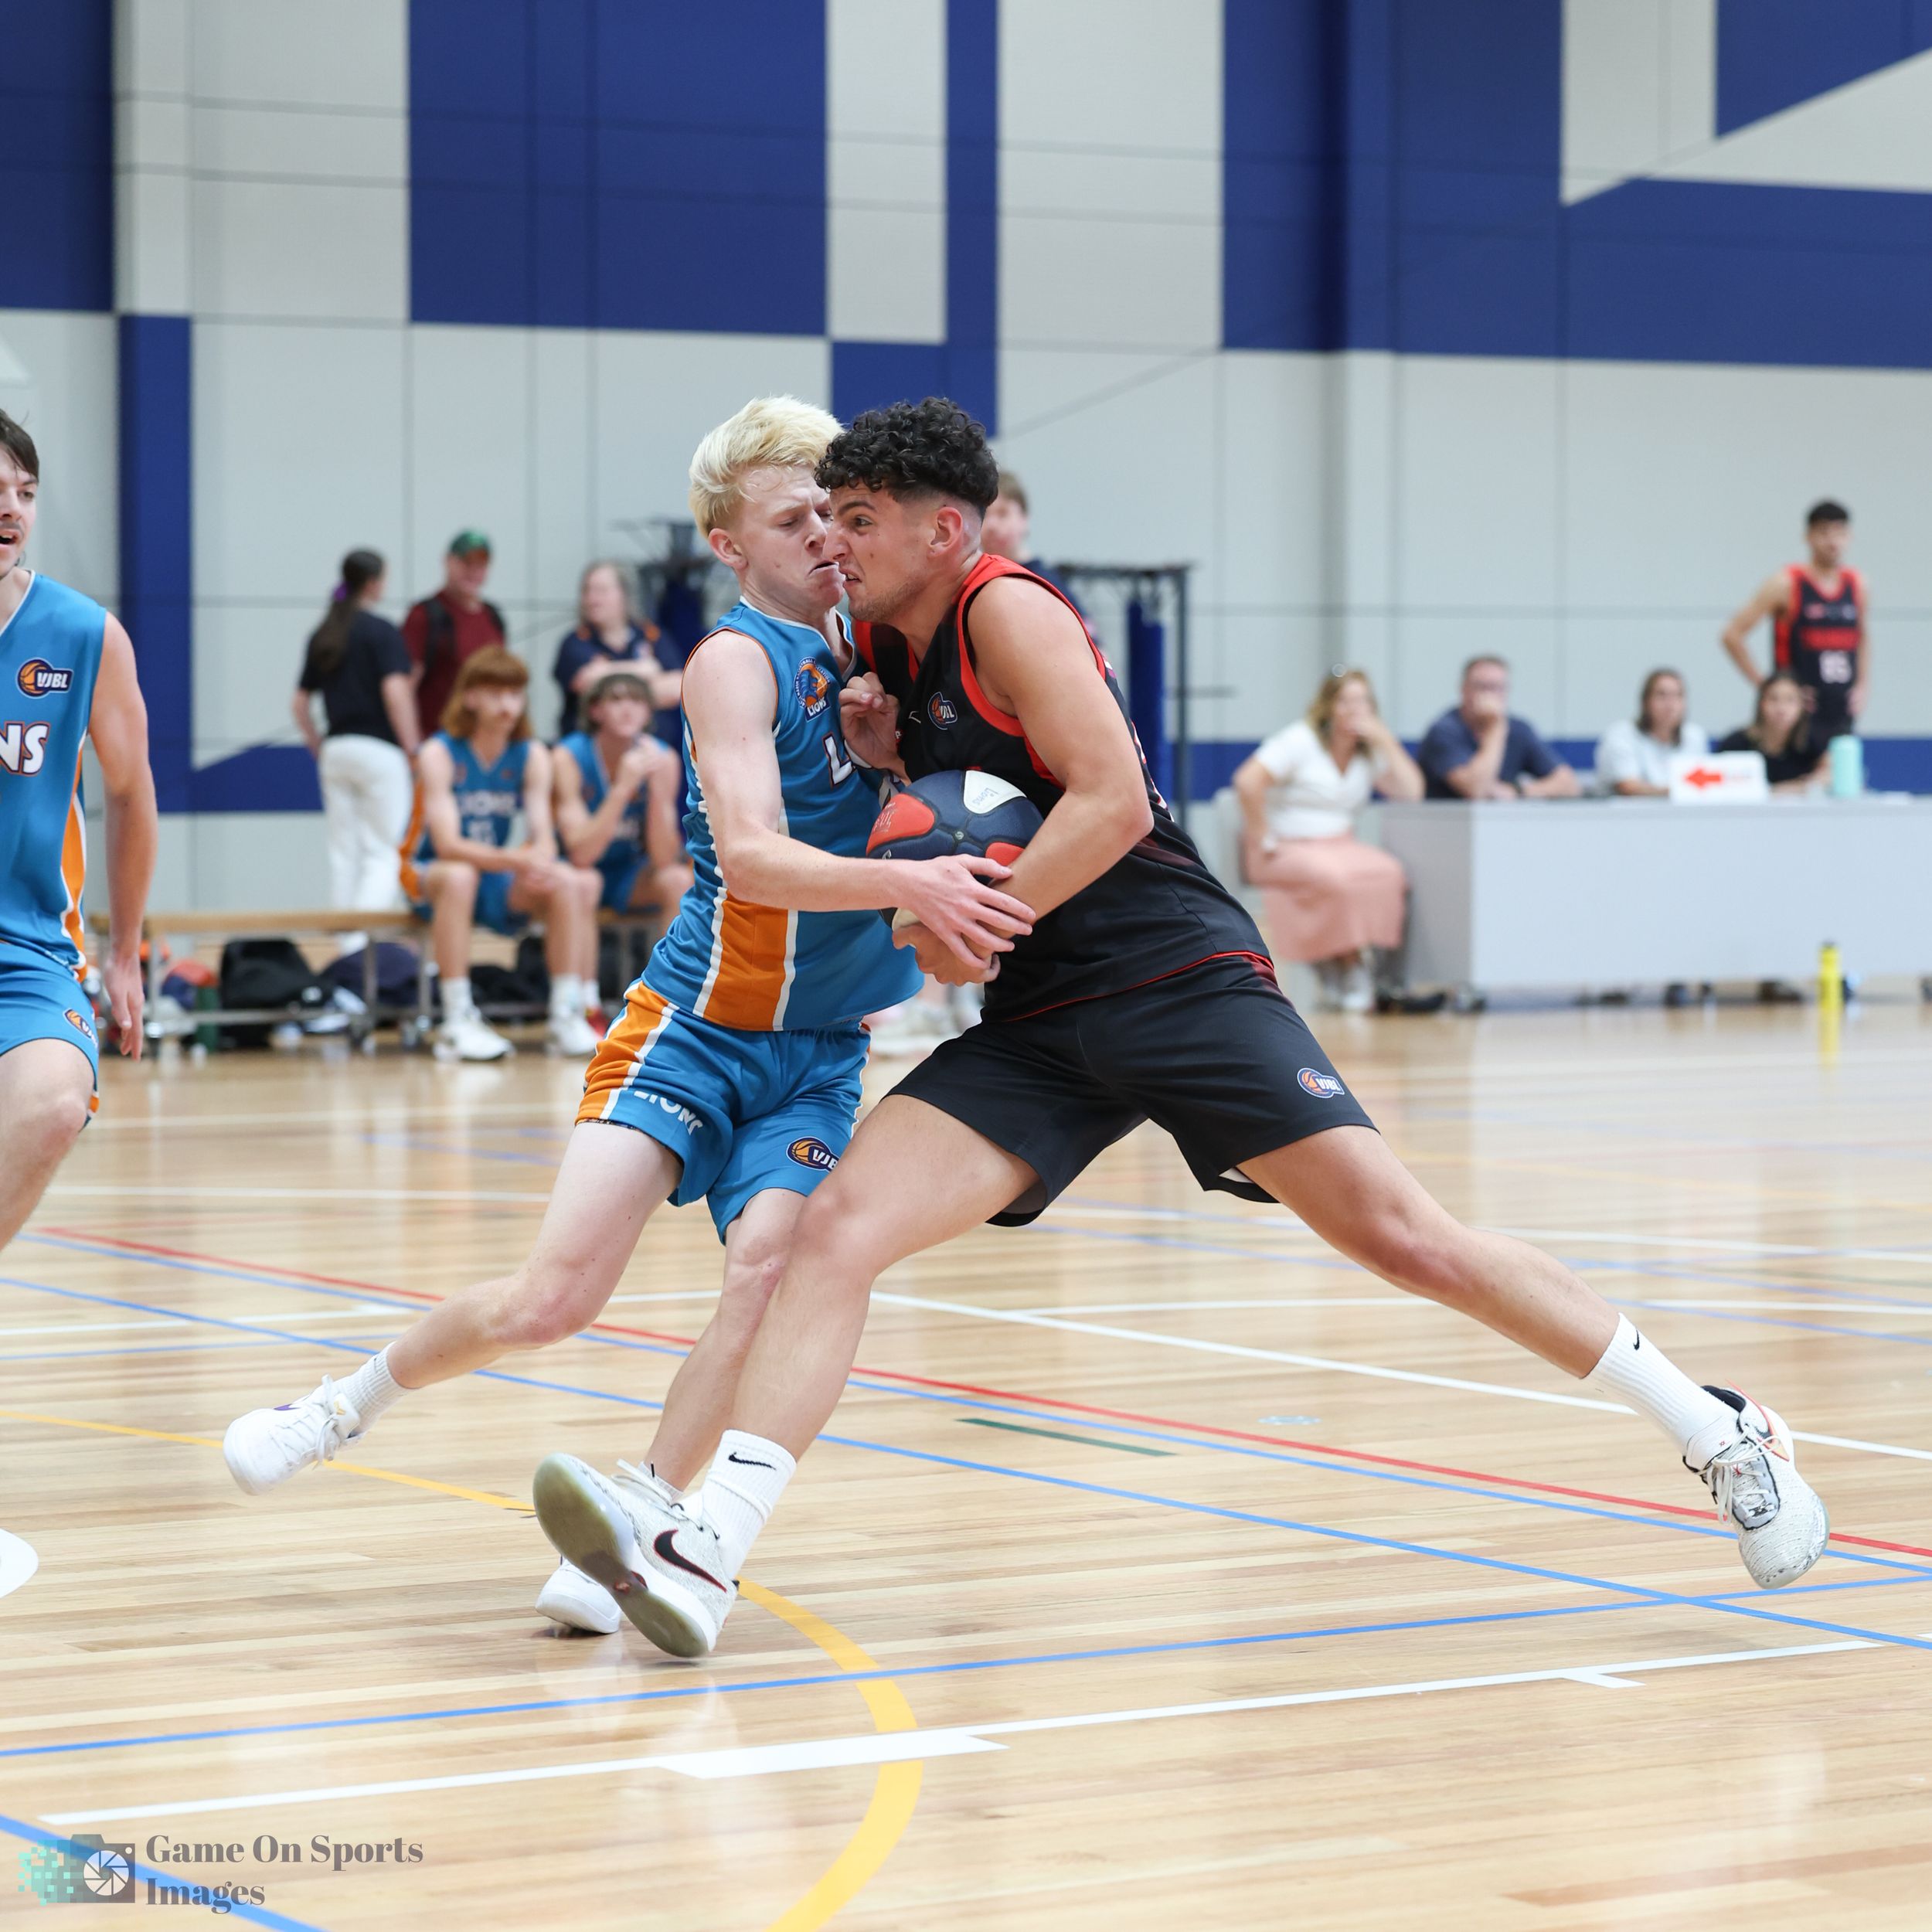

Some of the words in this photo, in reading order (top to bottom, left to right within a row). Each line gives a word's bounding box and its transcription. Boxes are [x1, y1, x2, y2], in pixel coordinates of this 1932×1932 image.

[36, 672, 68, 689] VJBL
[807, 697, 827, 716] LIONS
[1315, 1077, 1341, 1091] VJBL
[812, 1149, 838, 1169] VJB
